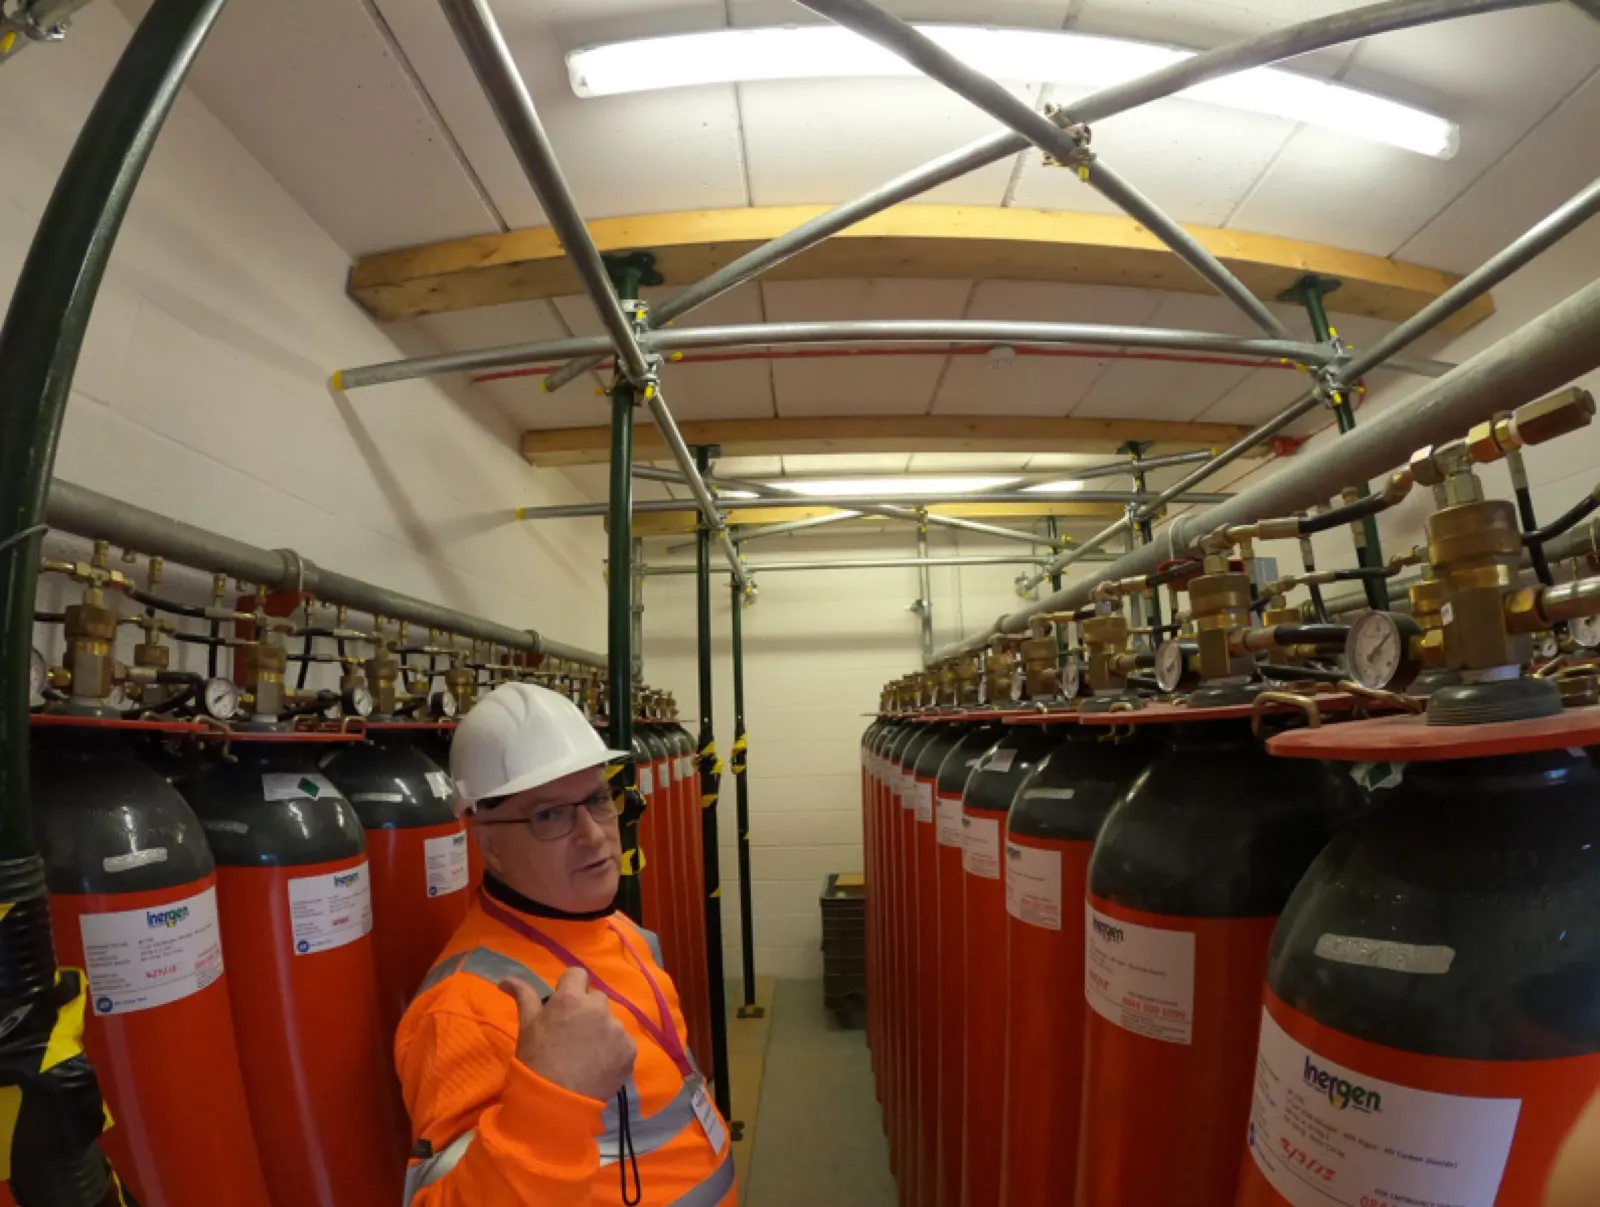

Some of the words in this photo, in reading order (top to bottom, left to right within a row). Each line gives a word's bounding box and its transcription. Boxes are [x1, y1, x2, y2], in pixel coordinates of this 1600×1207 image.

[147, 906, 189, 928] Inergen
[1092, 914, 1125, 943] Inergen
[1303, 1055, 1381, 1111] Inergen
